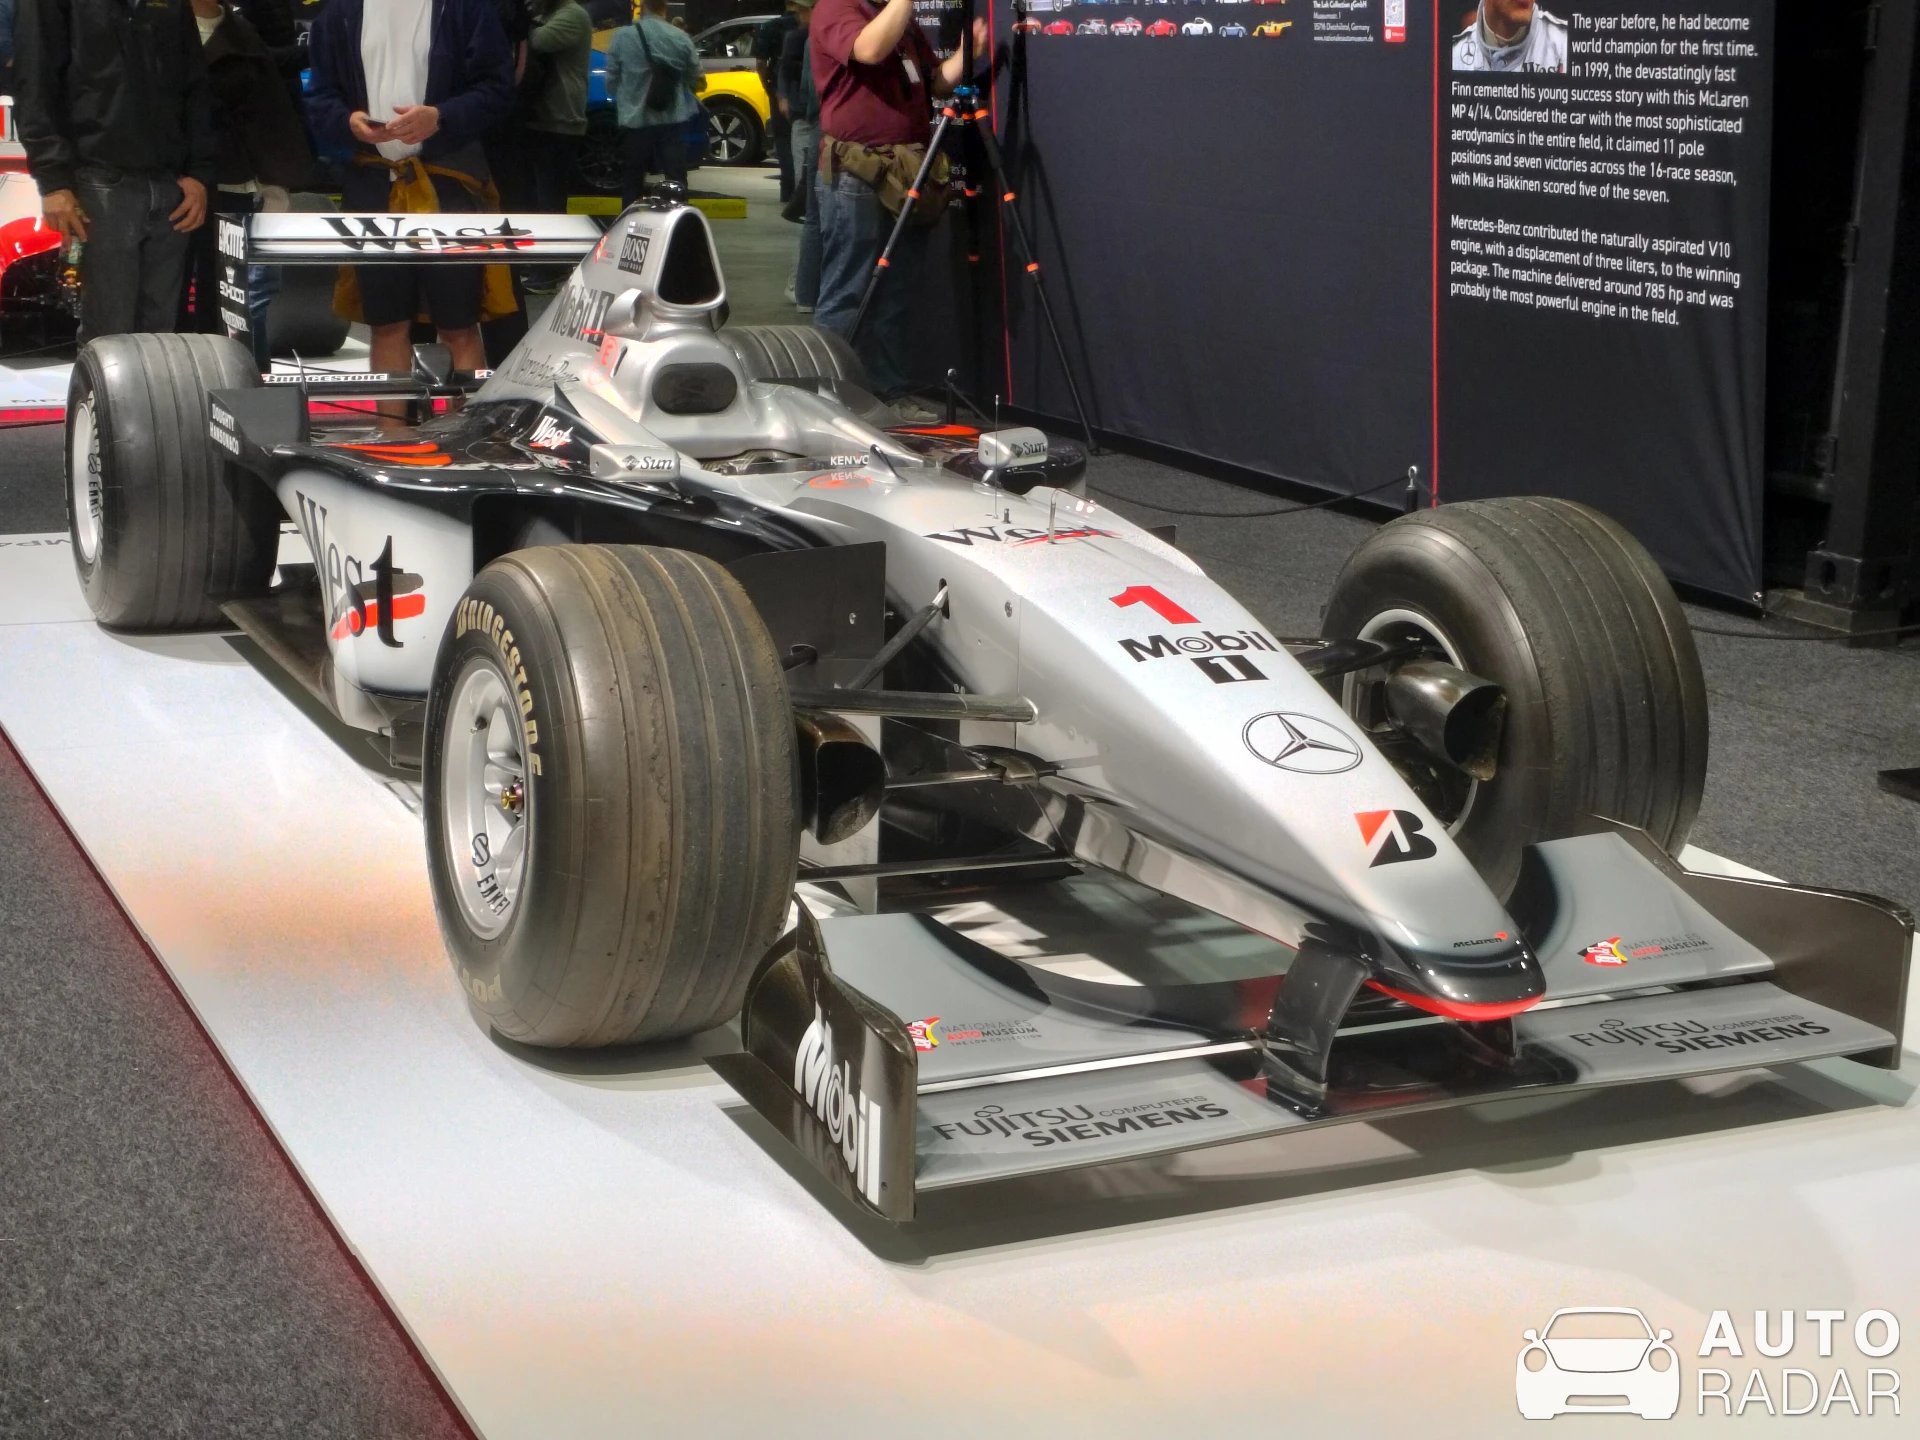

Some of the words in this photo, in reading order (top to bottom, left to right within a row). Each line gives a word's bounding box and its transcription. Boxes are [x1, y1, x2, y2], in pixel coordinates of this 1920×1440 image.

[1573, 13, 1592, 28] The
[1594, 17, 1618, 32] year
[1620, 13, 1658, 31] before,
[1662, 14, 1676, 30] he
[1679, 14, 1701, 30] had
[1704, 14, 1749, 30] become
[1571, 38, 1602, 53] world
[1604, 38, 1657, 57] champion
[1660, 39, 1677, 54] for
[1679, 40, 1699, 55] the
[1702, 40, 1724, 56] first
[1726, 41, 1758, 56] time.
[1571, 61, 1581, 76] in
[1585, 62, 1611, 79] 1999,
[1614, 63, 1632, 78] the
[1634, 63, 1712, 84] devastatingly
[1714, 66, 1736, 82] fast
[1451, 81, 1471, 96] Finn
[1473, 83, 1519, 98] cemented
[1521, 84, 1536, 99] his
[1538, 88, 1568, 104] young
[1570, 89, 1612, 102] success
[1615, 88, 1643, 106] story
[1646, 89, 1670, 104] with
[1673, 90, 1695, 105] this
[1699, 90, 1748, 108] McLaren
[1451, 104, 1467, 118] MP
[1468, 104, 1493, 120] 4/14.
[1494, 105, 1548, 123] Considered
[1551, 108, 1567, 124] the
[1569, 112, 1586, 124] car
[1588, 110, 1611, 126] with
[1614, 111, 1632, 127] the
[1635, 115, 1662, 129] most
[1665, 114, 1742, 133] sophisticated
[1451, 128, 1515, 145] aerodynamics
[1517, 131, 1526, 145] in
[1528, 131, 1544, 146] the
[1546, 133, 1576, 148] entire
[1578, 134, 1603, 151] field,
[1606, 135, 1613, 150] it
[1616, 136, 1659, 153] claimed
[1664, 139, 1674, 154] 11
[1678, 140, 1704, 158] pole
[1451, 150, 1492, 166] positions
[1493, 152, 1511, 166] and
[1513, 156, 1542, 168] seven
[1544, 155, 1587, 172] victories
[1590, 161, 1625, 175] across
[1628, 161, 1646, 176] the
[1651, 162, 1690, 180] 16-race
[1694, 168, 1736, 185] season,
[1450, 171, 1470, 185] with
[1472, 172, 1494, 188] Mika
[1496, 173, 1540, 192] Häkkinen
[1542, 180, 1576, 195] scored
[1578, 180, 1597, 196] five
[1599, 183, 1610, 198] of
[1612, 184, 1630, 199] the
[1633, 188, 1669, 203] seven.
[320, 217, 534, 251] West
[622, 237, 648, 263] BOSS
[1451, 215, 1521, 235] Mercedes-Benz
[1522, 224, 1578, 242] contributed
[1581, 228, 1598, 244] the
[1600, 232, 1649, 252] naturally
[1651, 237, 1704, 255] aspirated
[1708, 240, 1730, 256] V10
[1450, 239, 1483, 255] engine,
[1484, 242, 1505, 256] with
[1507, 247, 1514, 257] a
[1515, 245, 1580, 265] displacement
[1582, 253, 1593, 267] of
[1595, 254, 1623, 270] three
[1626, 257, 1657, 276] liters,
[1661, 261, 1673, 276] to
[1675, 262, 1692, 278] the
[1695, 265, 1740, 287] winning
[1450, 260, 1490, 278] package.
[1494, 264, 1510, 279] The
[1512, 268, 1552, 284] machine
[1554, 271, 1601, 291] delivered
[1604, 280, 1642, 296] around
[1644, 282, 1665, 299] 785
[1668, 285, 1683, 304] hp
[1686, 289, 1706, 304] and
[1709, 294, 1733, 307] was
[549, 284, 599, 342] Mobil
[1450, 282, 1490, 301] probably
[1492, 286, 1508, 300] the
[1509, 290, 1533, 304] most
[1536, 294, 1579, 311] powerful
[1581, 300, 1616, 318] engine
[1619, 302, 1628, 318] in
[1631, 304, 1648, 321] the
[1651, 307, 1679, 325] field.
[263, 374, 388, 382] BRIDGESTONE
[211, 402, 235, 432] DOUGHTY
[530, 415, 574, 450] West
[640, 456, 673, 470] Sun
[830, 456, 869, 466] KENWO
[1023, 440, 1048, 455] Sun
[923, 525, 1124, 548] West
[295, 490, 404, 648] West
[1108, 585, 1202, 624] 1
[1117, 630, 1280, 662] Mobil
[456, 596, 543, 777] BRIDGESTONE
[476, 872, 512, 918] ENKEI
[1453, 937, 1503, 948] McLaren
[1624, 932, 1702, 951] NATIONALES
[1632, 940, 1709, 957] AUTOMUSEUM
[940, 1020, 1032, 1034] NATIONALES
[946, 1027, 1039, 1041] AUTOMUSEUM
[1570, 1019, 1711, 1050] FUJITSU
[1712, 1014, 1806, 1032] COMPUTERS
[1654, 1020, 1832, 1055] SIEMENS
[794, 1016, 882, 1206] Mobil
[931, 1104, 1095, 1142] FUJITSU
[1098, 1094, 1208, 1117] COMPUTERS
[1021, 1102, 1230, 1148] SIEMENS
